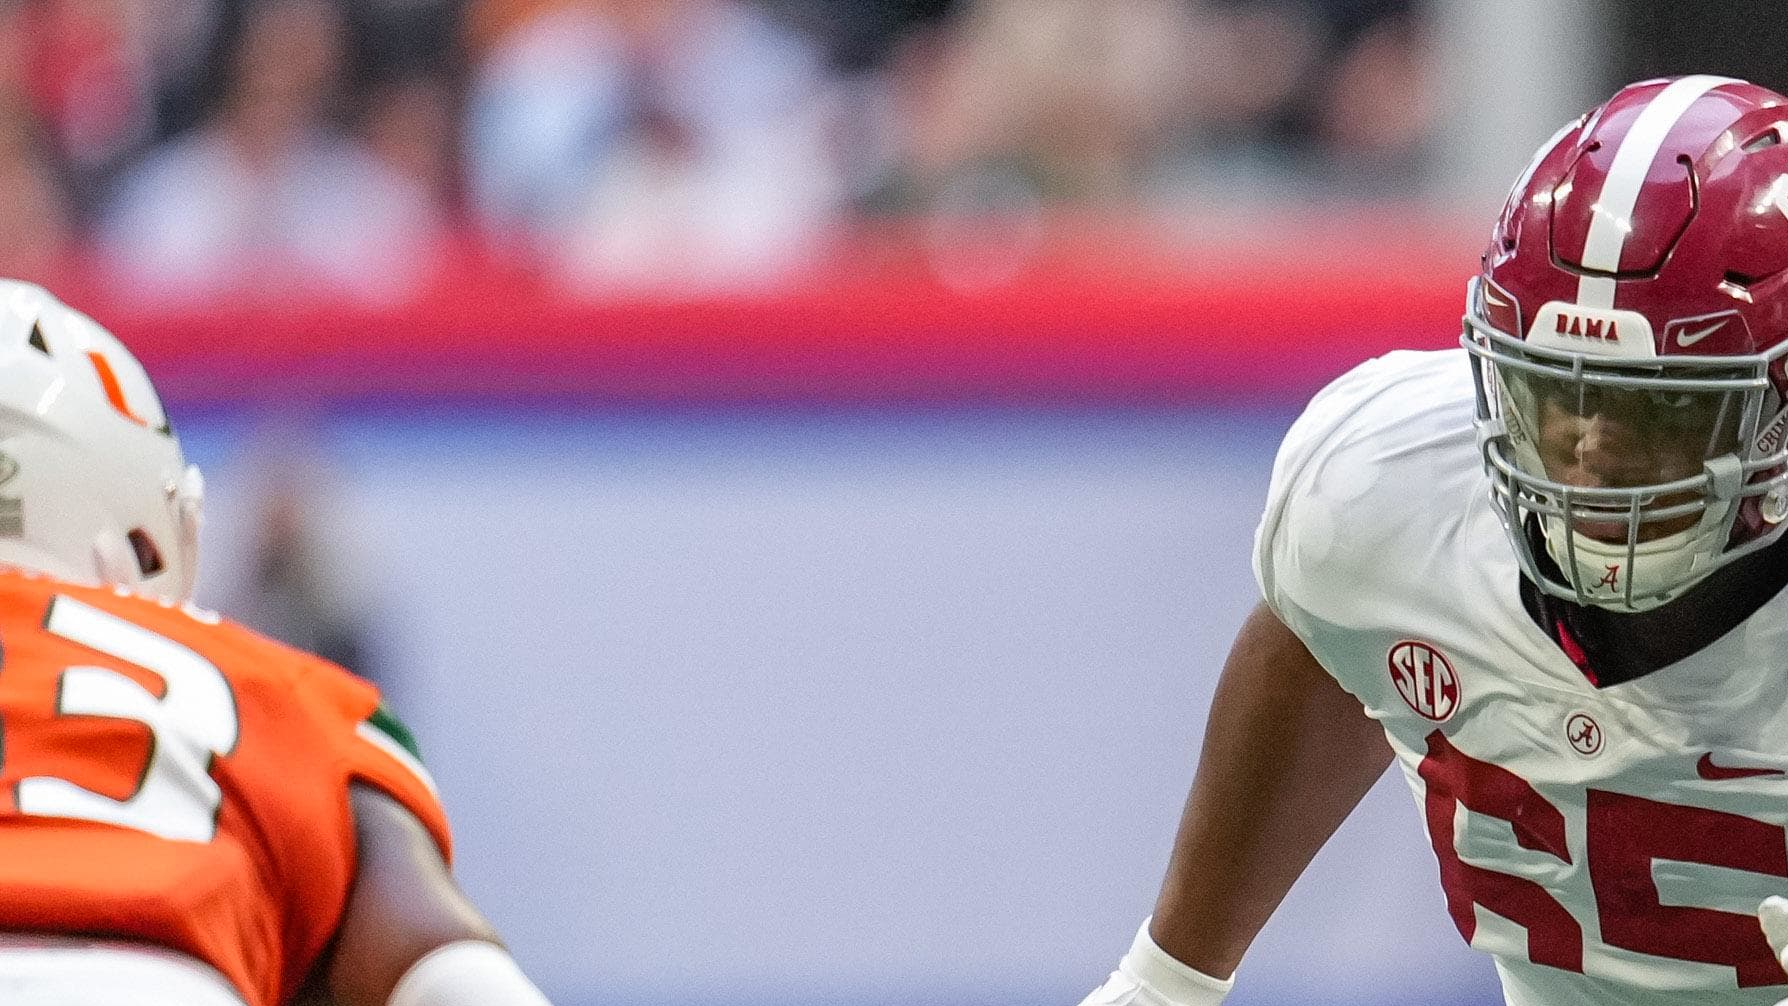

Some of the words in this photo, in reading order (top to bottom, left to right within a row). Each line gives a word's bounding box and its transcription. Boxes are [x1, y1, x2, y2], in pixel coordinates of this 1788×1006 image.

[1555, 313, 1619, 341] BAMA
[0, 593, 240, 844] 3
[1392, 644, 1453, 719] SEC
